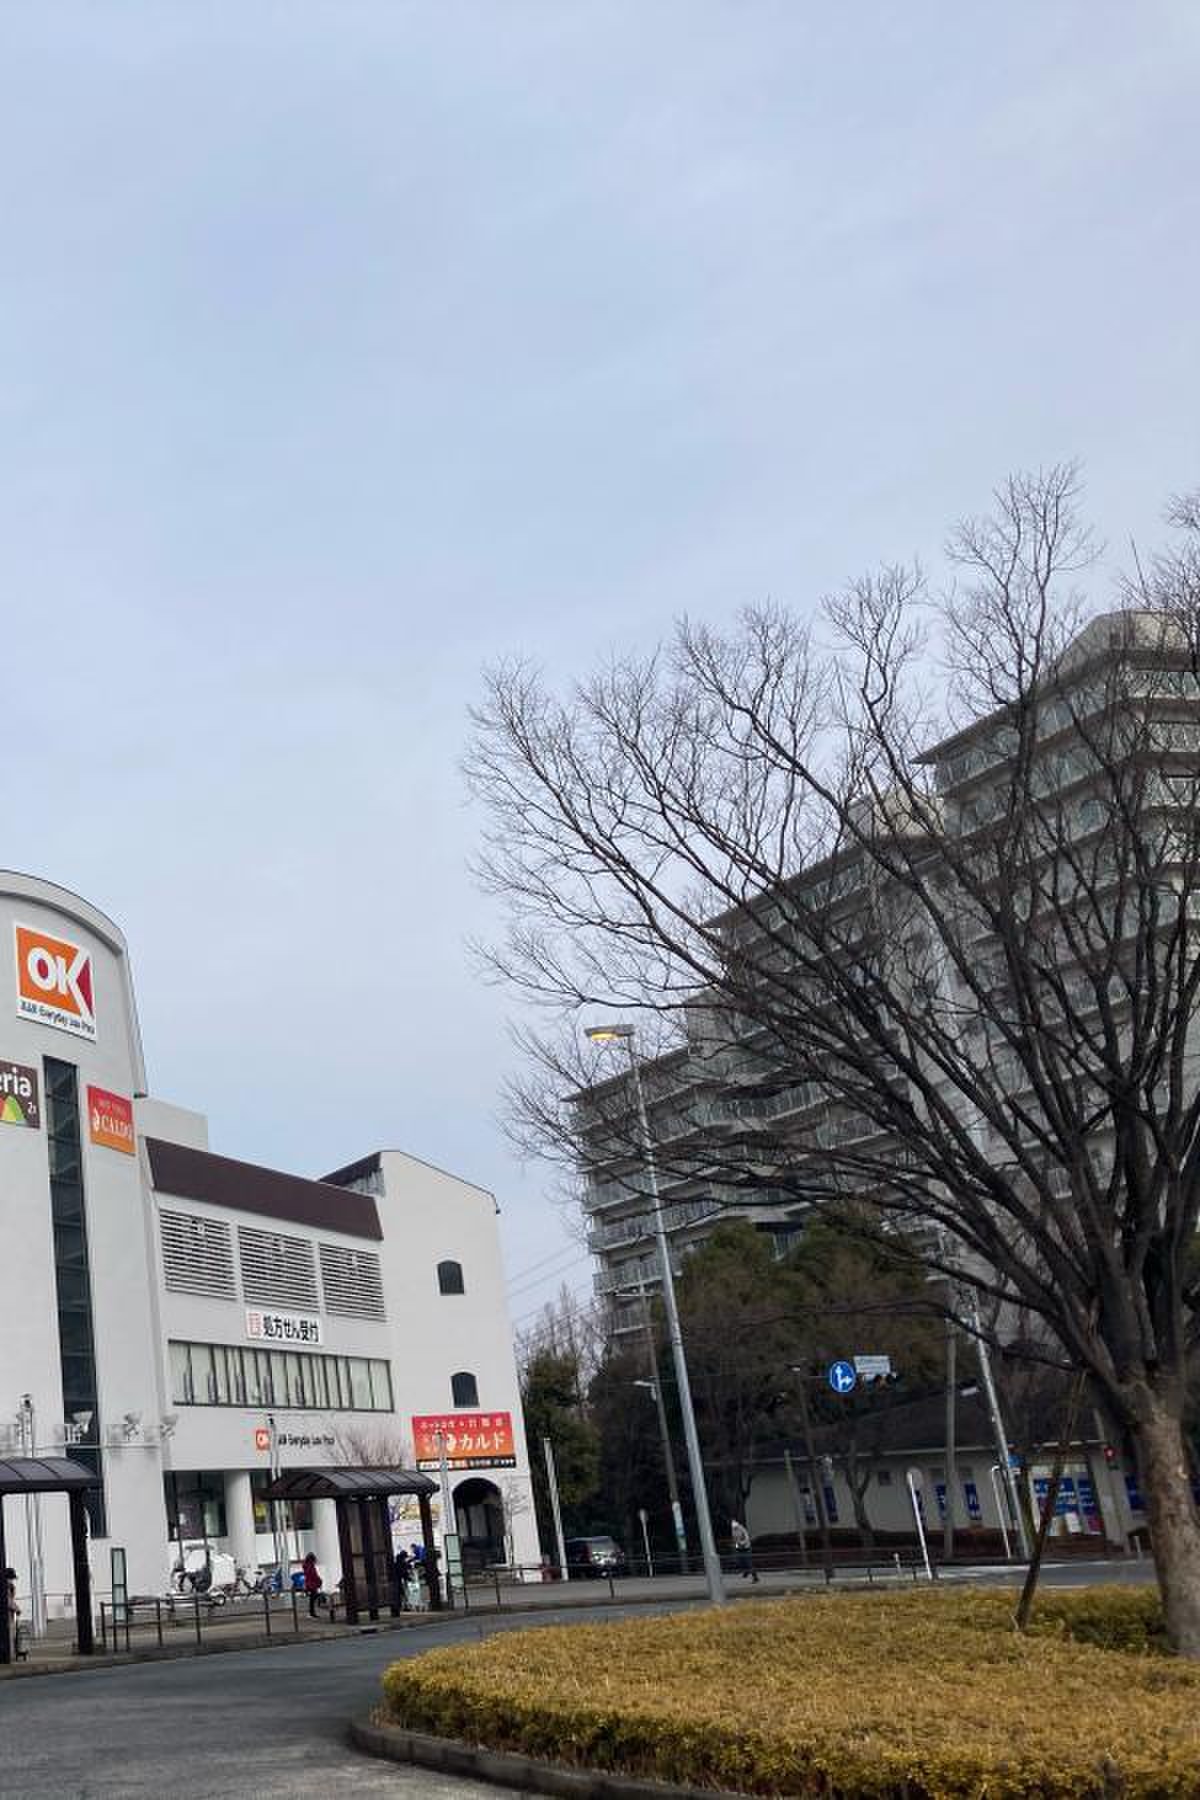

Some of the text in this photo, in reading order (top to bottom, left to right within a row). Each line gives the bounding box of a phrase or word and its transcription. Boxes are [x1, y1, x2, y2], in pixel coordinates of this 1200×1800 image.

[27, 946, 94, 1018] OK
[263, 1314, 319, 1342] 処方せん受付
